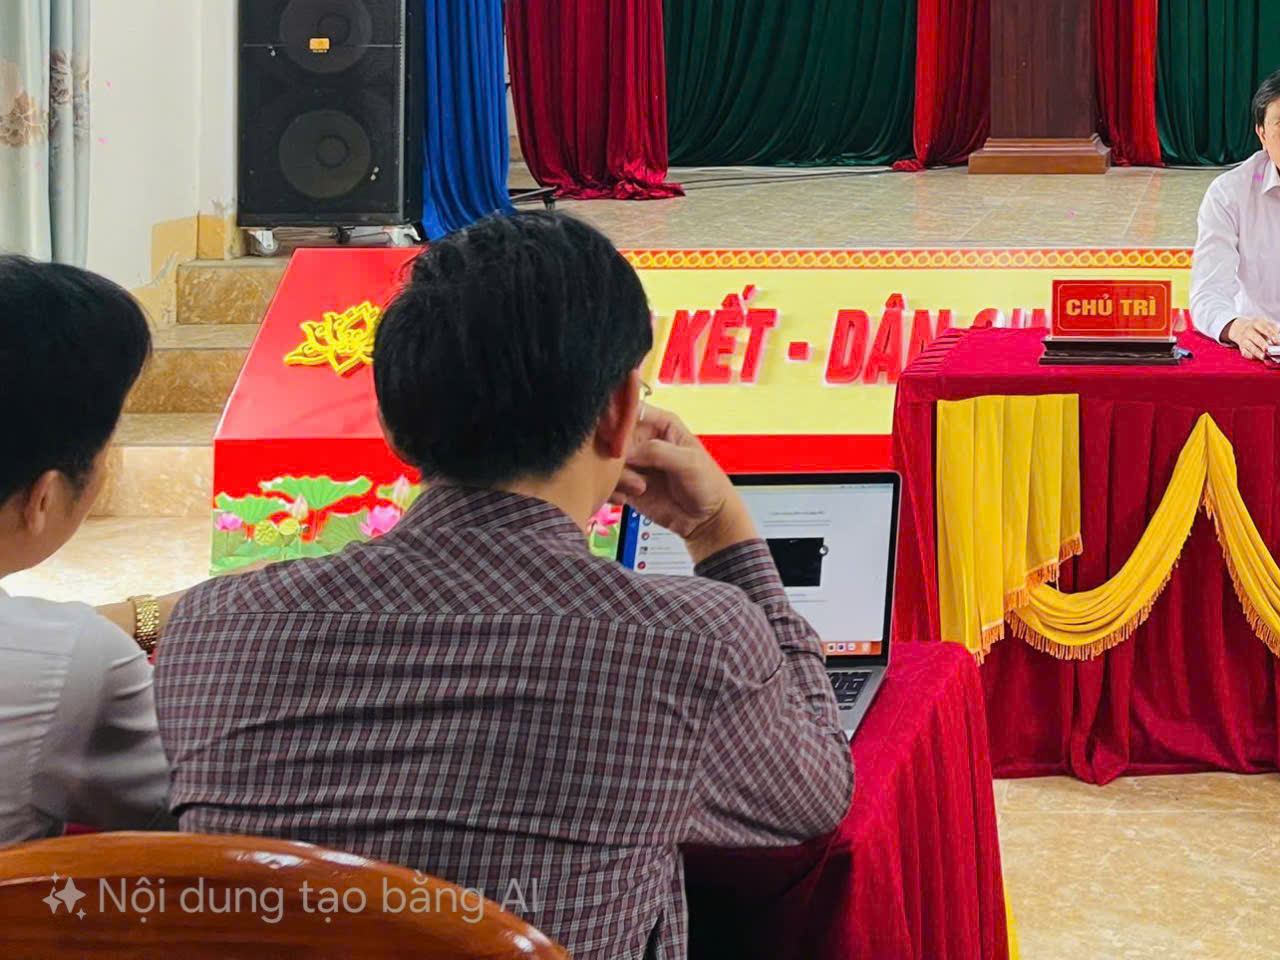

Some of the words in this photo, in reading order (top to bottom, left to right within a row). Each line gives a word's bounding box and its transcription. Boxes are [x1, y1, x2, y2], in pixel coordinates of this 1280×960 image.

[658, 284, 779, 385] KẾT
[788, 340, 810, 362] -
[1066, 294, 1113, 316] CHỦ
[1119, 295, 1156, 316] TRÌ
